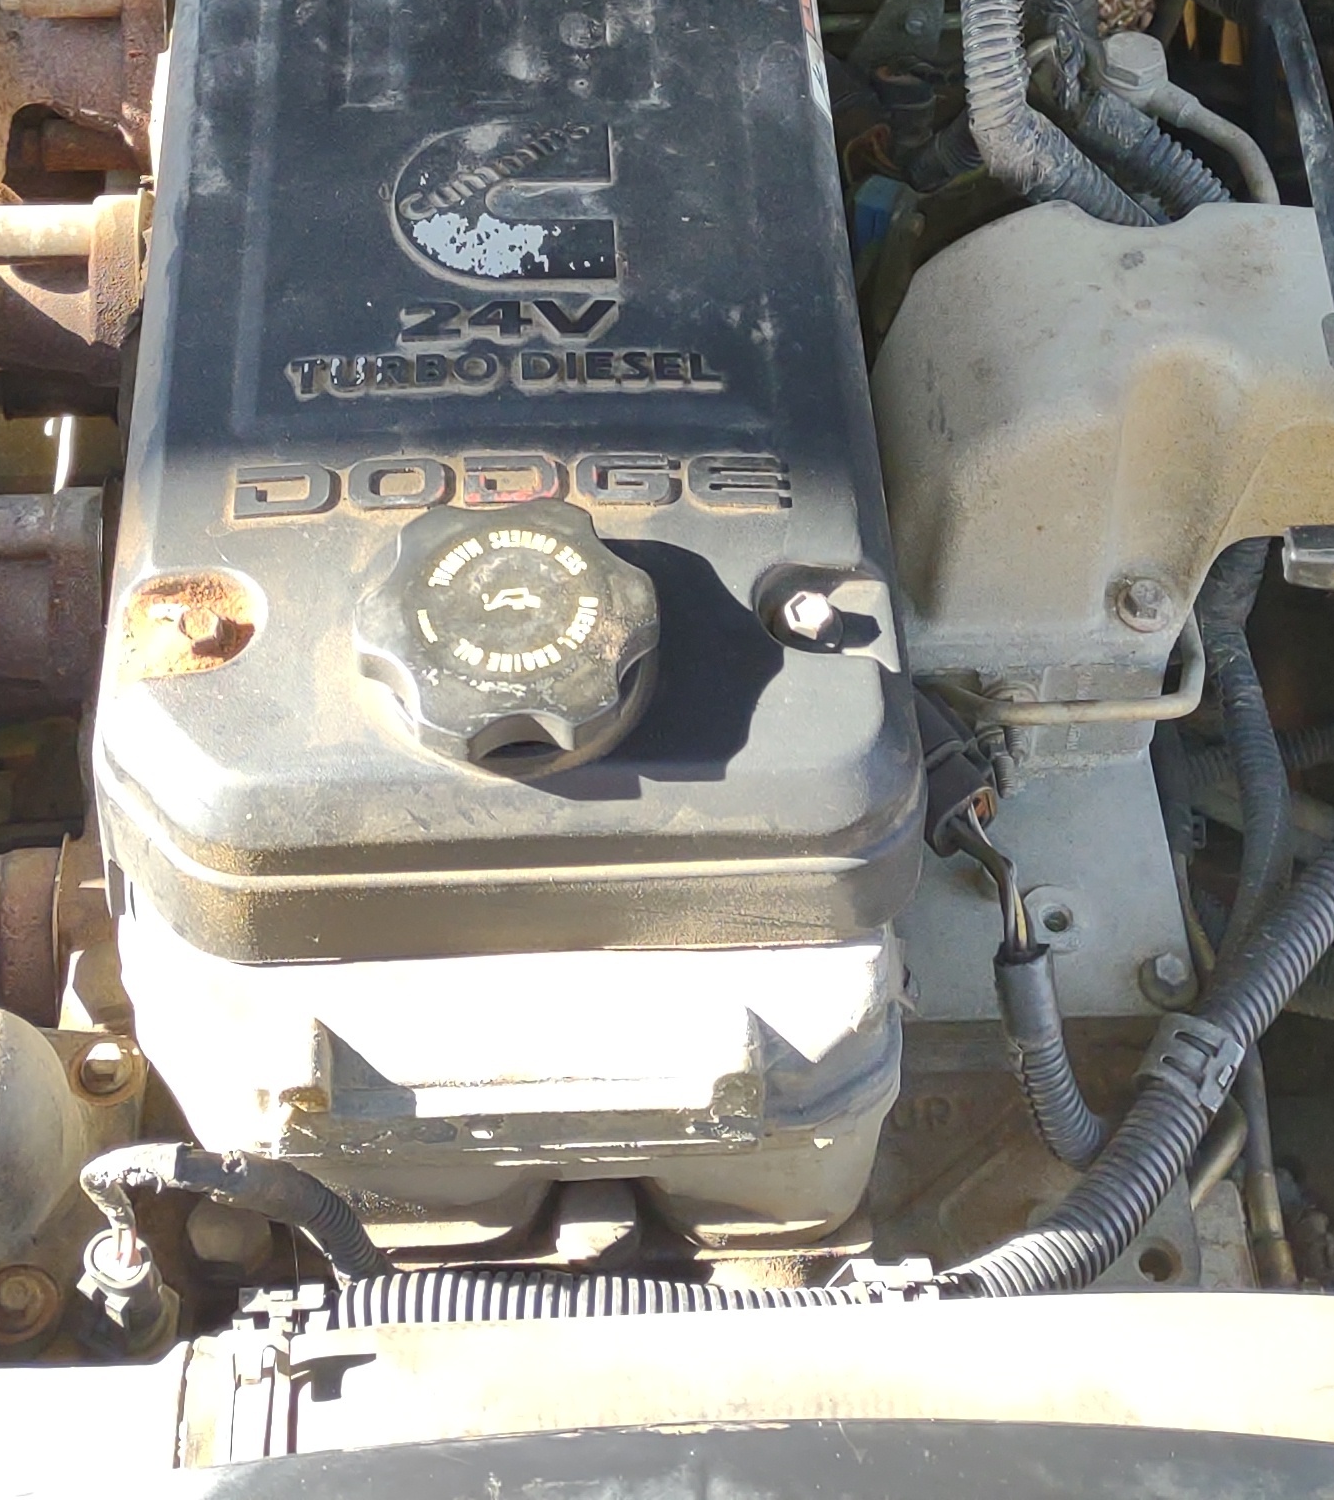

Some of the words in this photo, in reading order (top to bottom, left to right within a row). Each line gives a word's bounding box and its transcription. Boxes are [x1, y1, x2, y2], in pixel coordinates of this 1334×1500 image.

[400, 299, 618, 343] 24V
[289, 352, 499, 396] TURBO
[520, 350, 724, 386] DIESEL
[232, 453, 793, 521] DODGE
[427, 537, 484, 588] MANUAL
[554, 545, 588, 576] SEE
[556, 595, 599, 650] DIESEL
[453, 637, 484, 666] OIL
[485, 643, 562, 673] ENGINE
